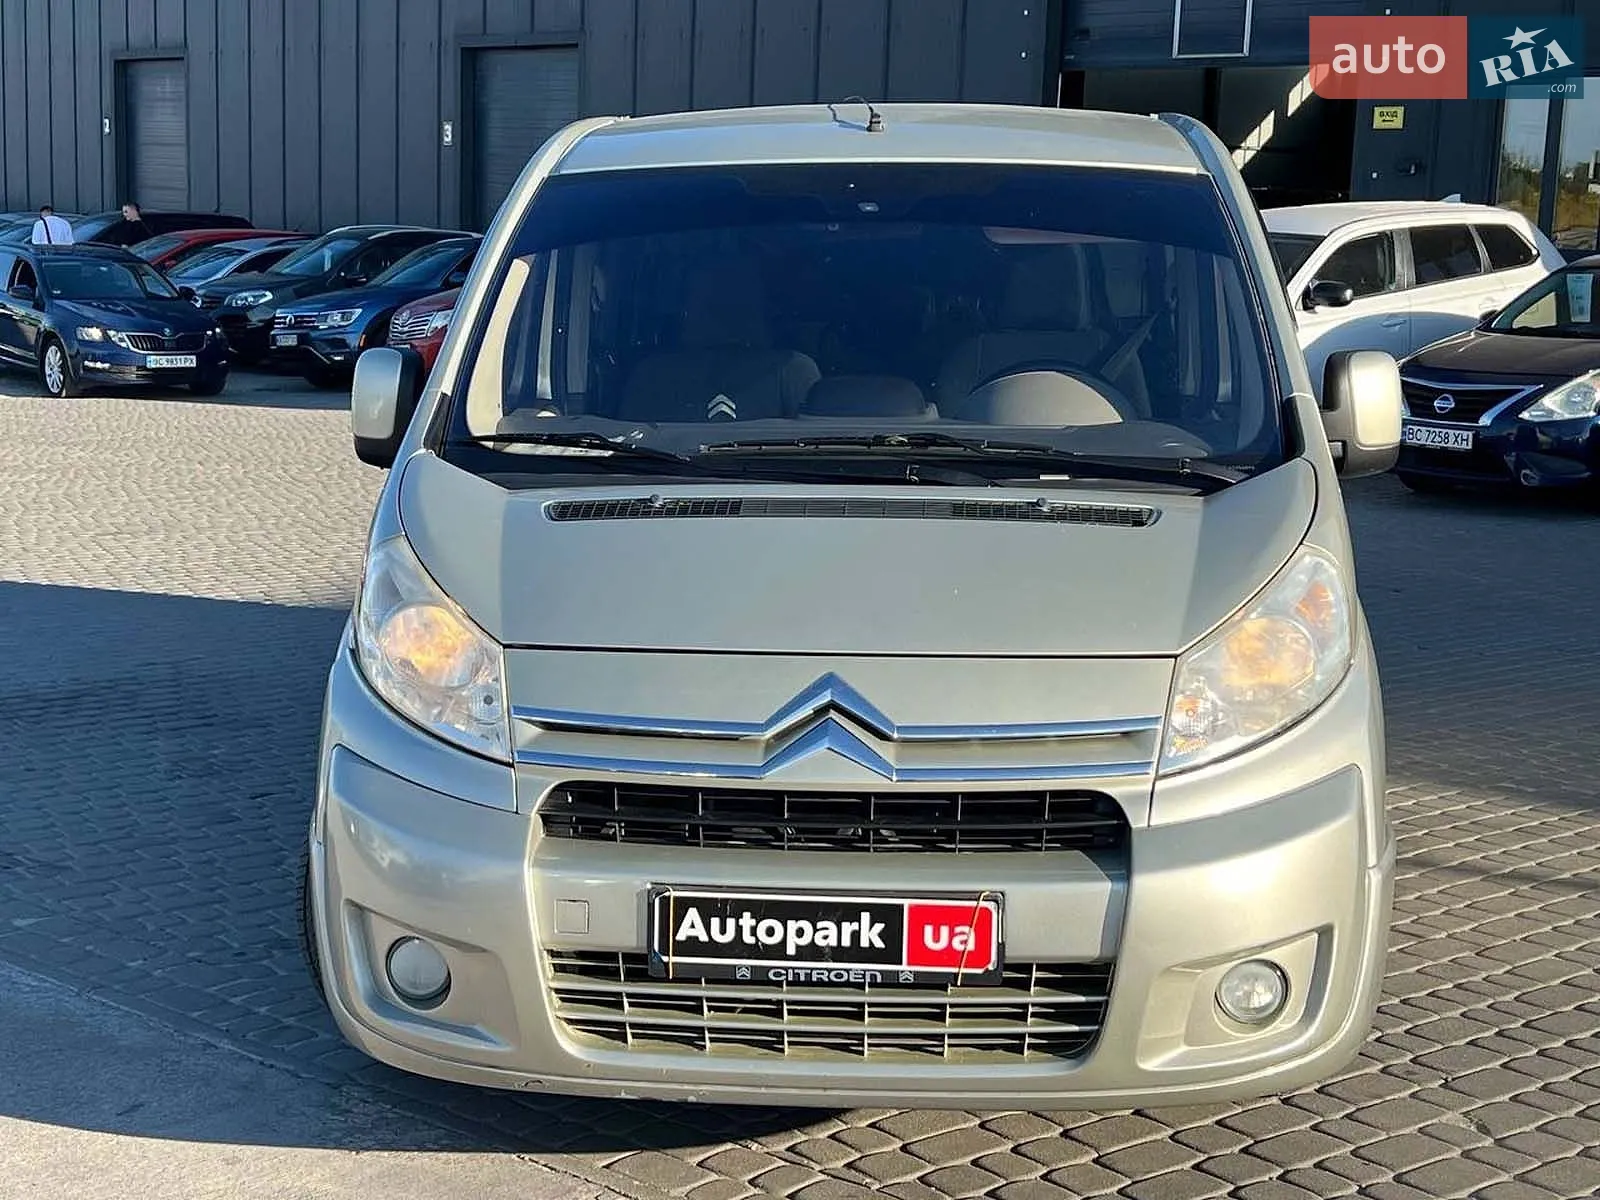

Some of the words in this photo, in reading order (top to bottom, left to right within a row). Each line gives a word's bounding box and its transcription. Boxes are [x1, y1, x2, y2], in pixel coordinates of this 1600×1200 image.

[1408, 427, 1422, 441] BC
[1425, 429, 1450, 445] 7258
[1453, 432, 1470, 447] XH
[676, 907, 886, 955] Autopark
[923, 922, 976, 952] ua
